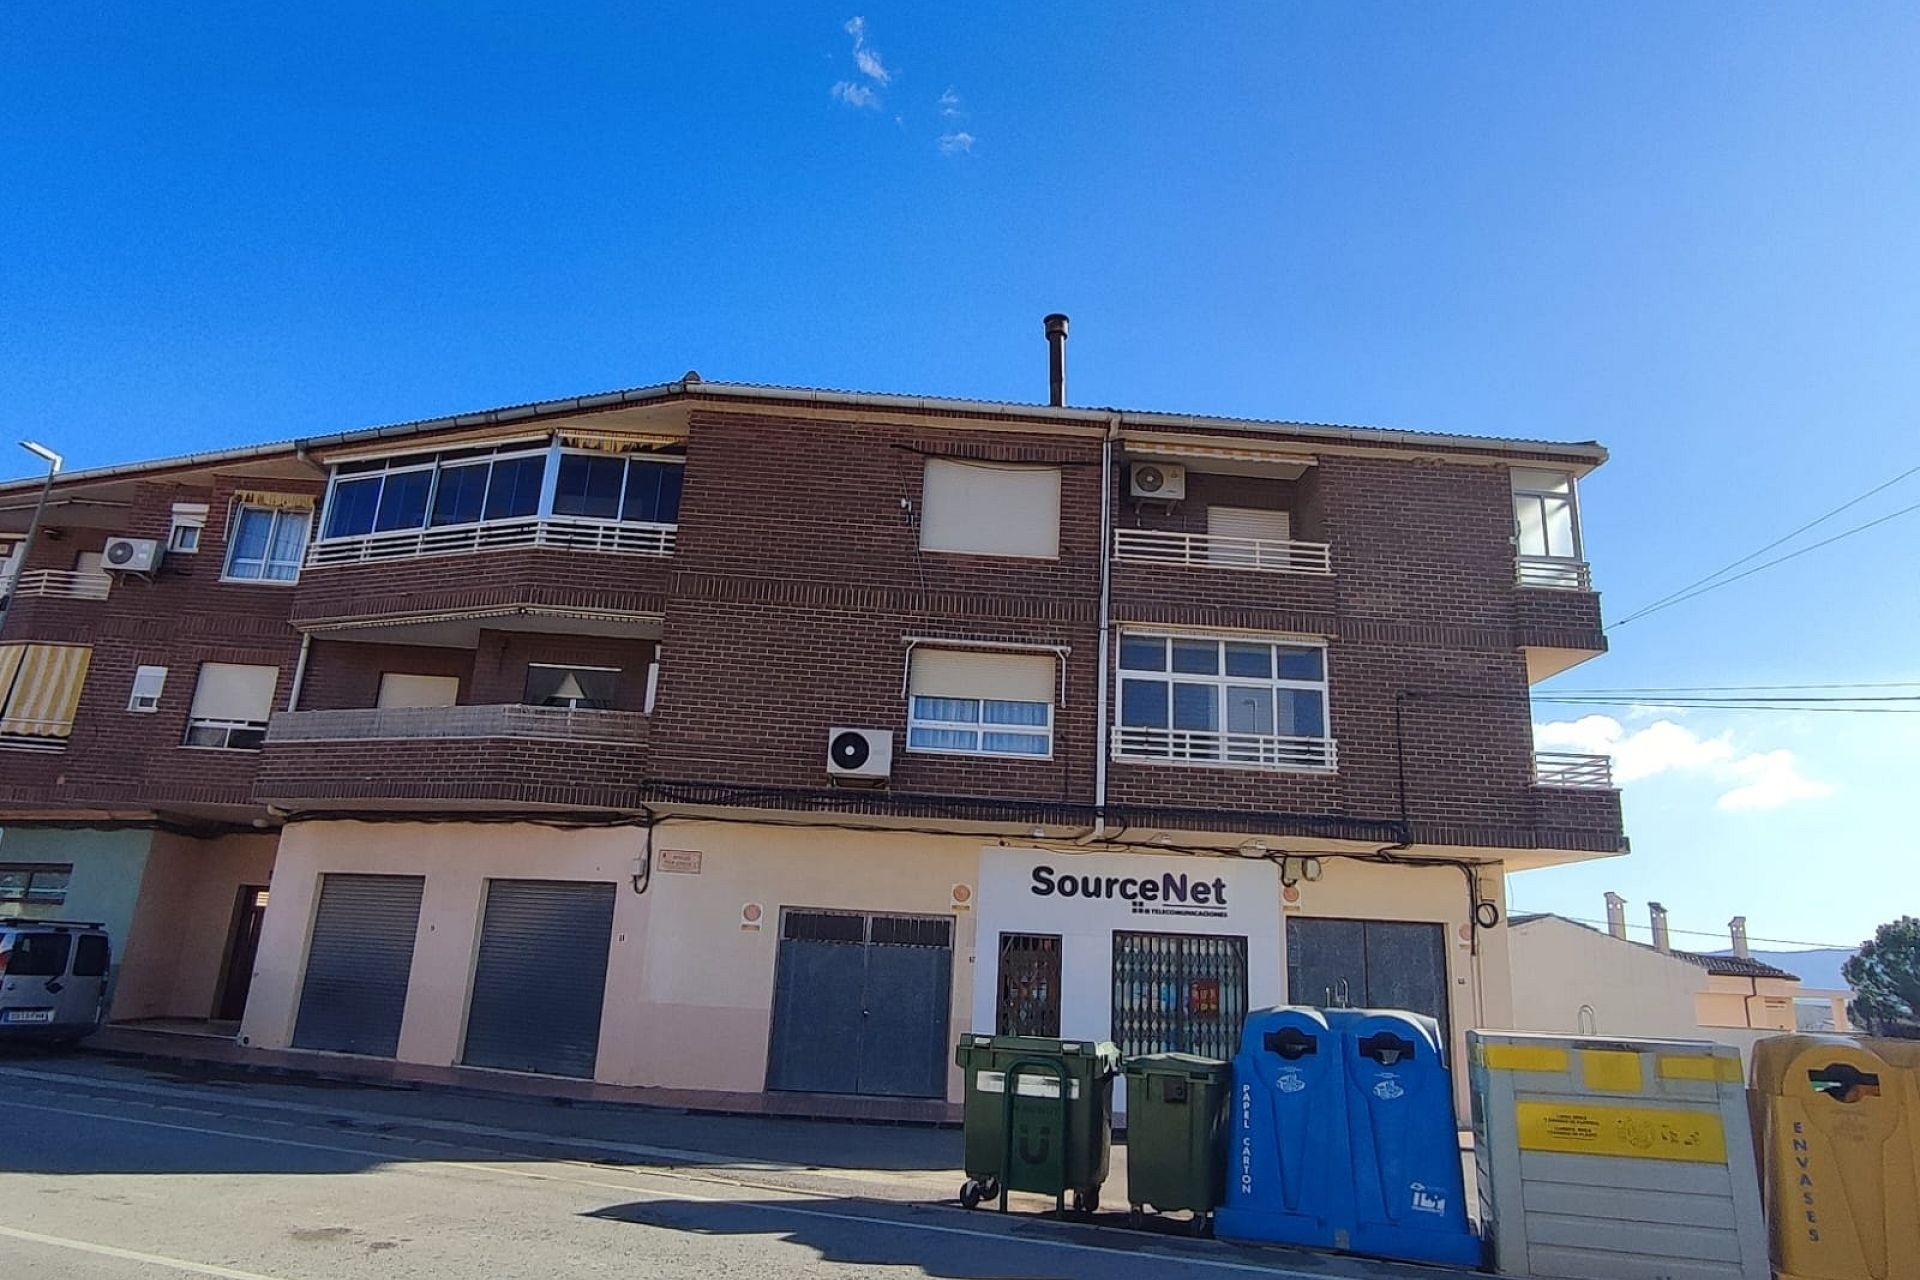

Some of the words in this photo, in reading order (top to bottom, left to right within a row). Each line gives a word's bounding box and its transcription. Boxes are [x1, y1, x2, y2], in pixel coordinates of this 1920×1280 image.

[1031, 866, 1227, 904] SourceNet
[1242, 1084, 1251, 1129] PAPEL
[1242, 1137, 1252, 1194] CARTON
[1792, 1121, 1820, 1242] ENVASES
